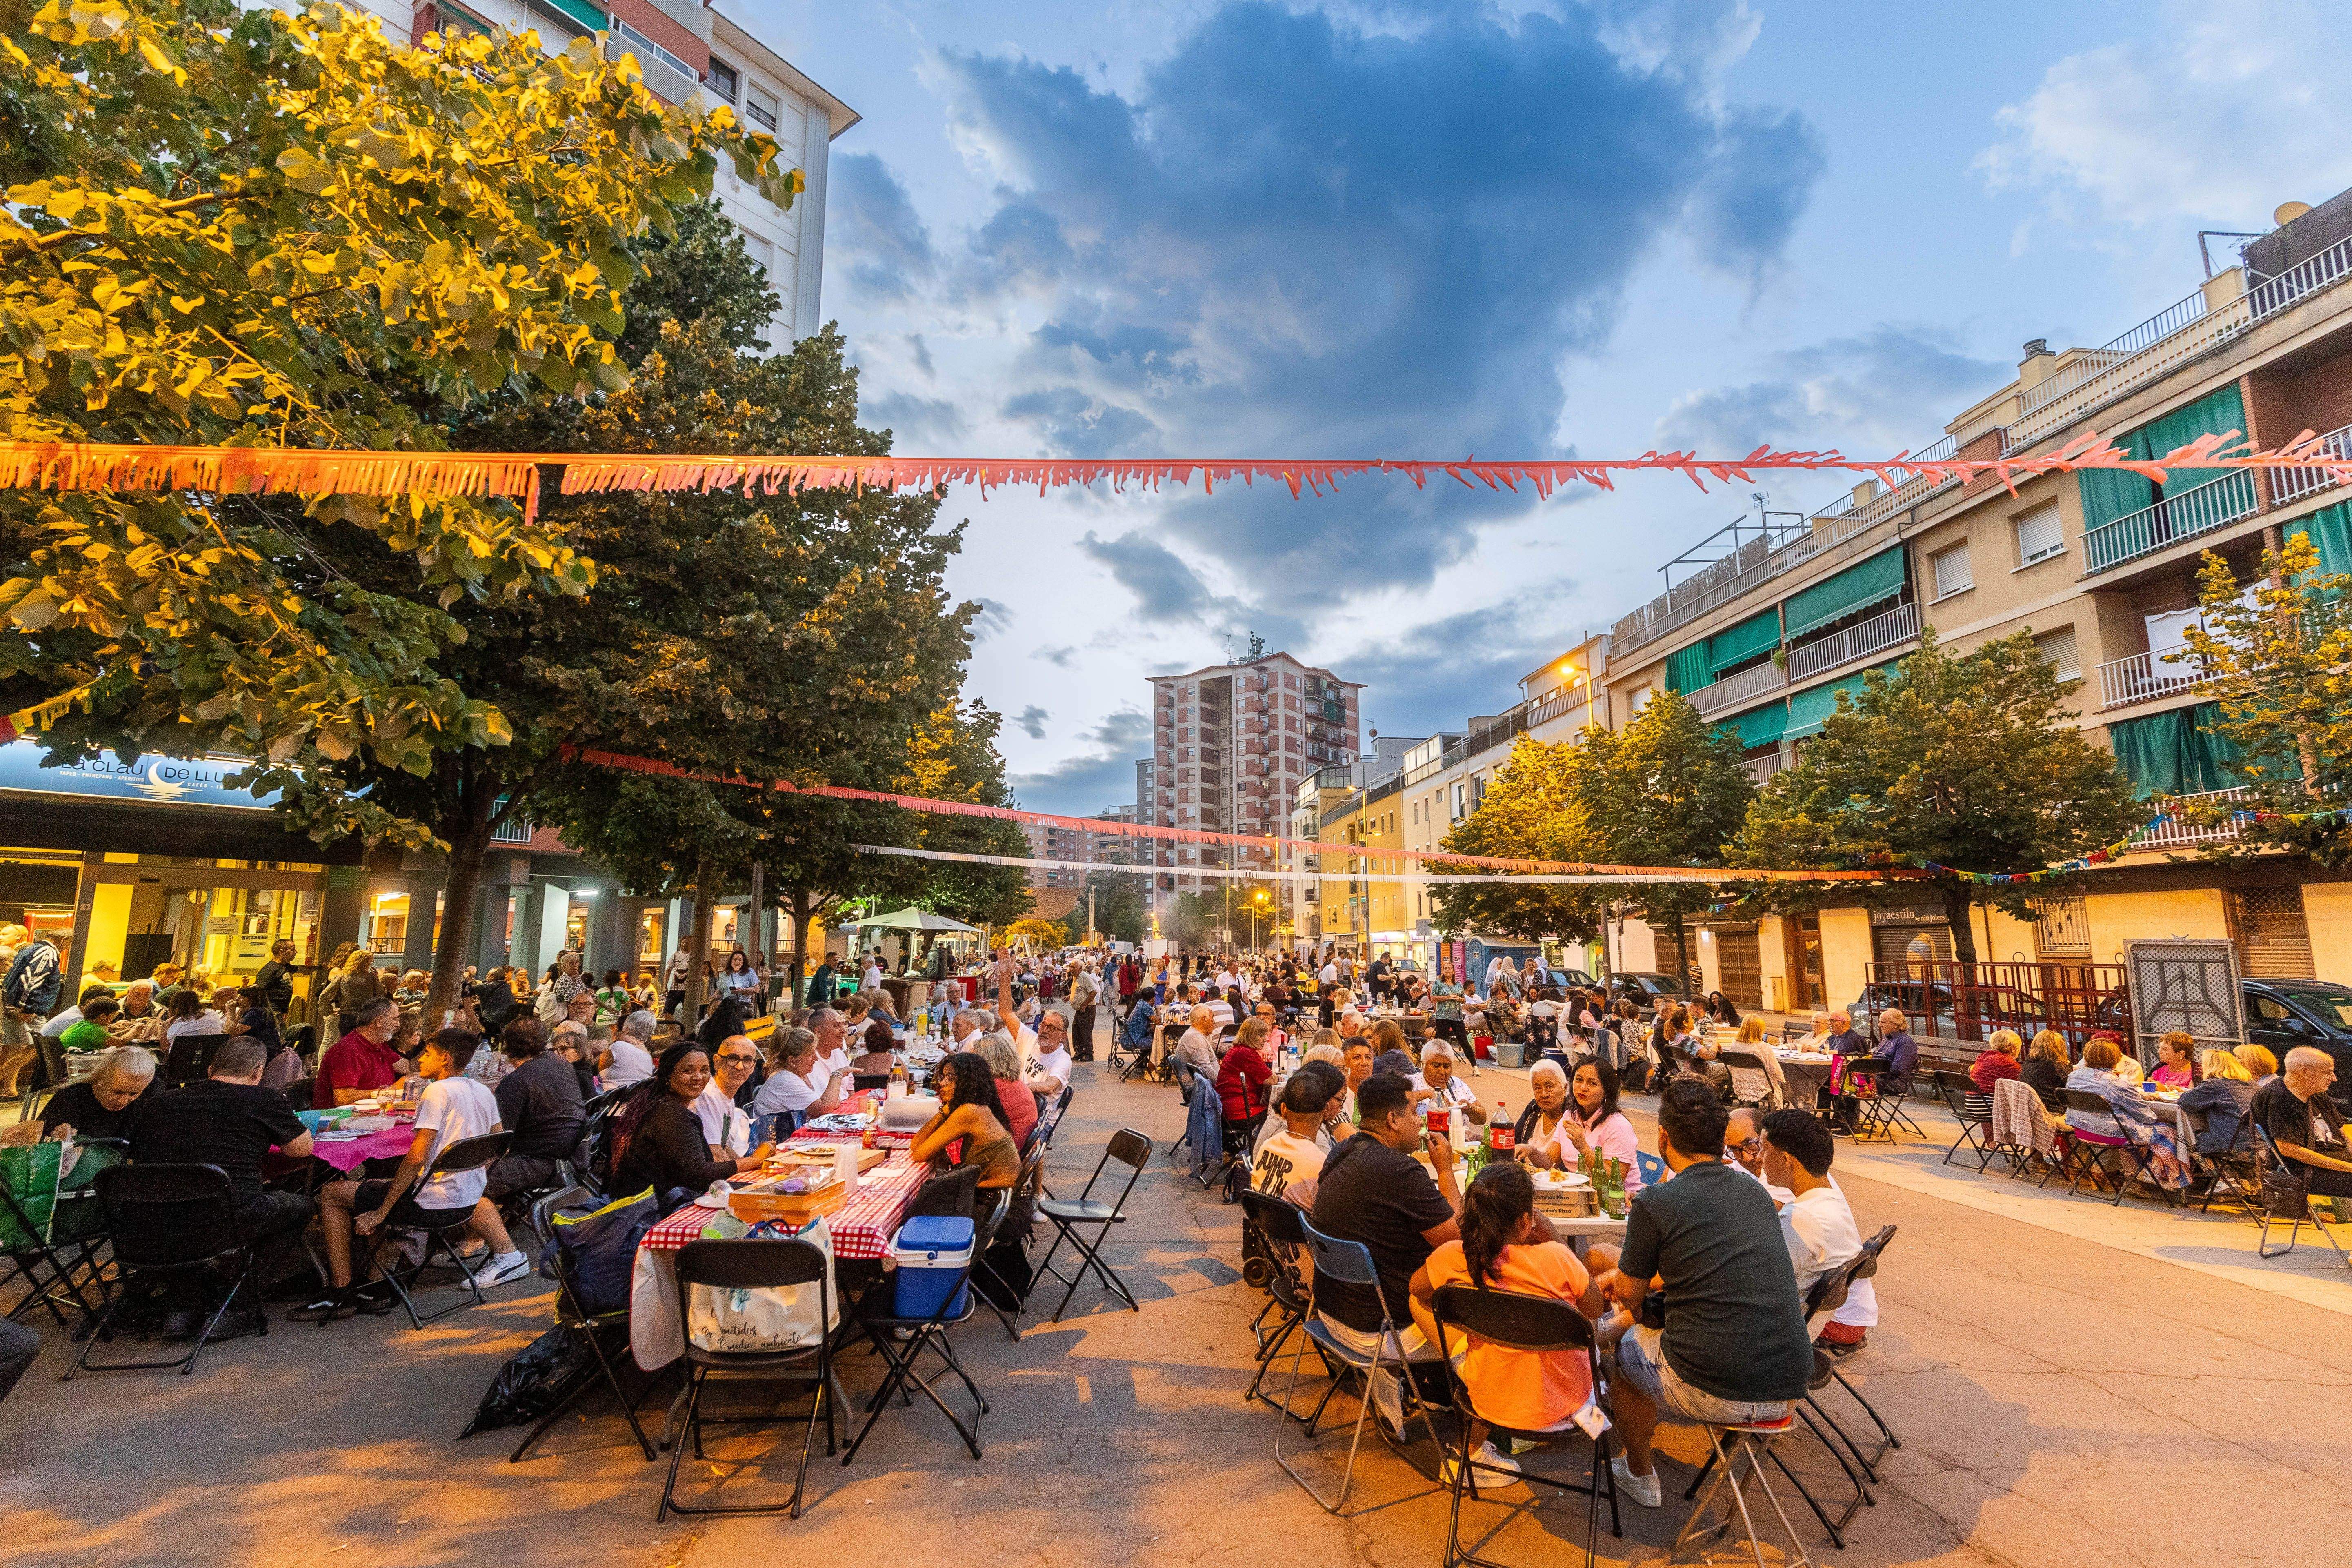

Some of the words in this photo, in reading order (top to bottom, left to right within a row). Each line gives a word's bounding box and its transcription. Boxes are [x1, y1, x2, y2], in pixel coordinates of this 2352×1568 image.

[1873, 907, 1914, 923] joyaestilo
[1930, 914, 1945, 923] joiers
[1027, 1054, 1046, 1073] UTUR
[1025, 1065, 1039, 1079] IFE
[761, 1332, 802, 1348] ambiente
